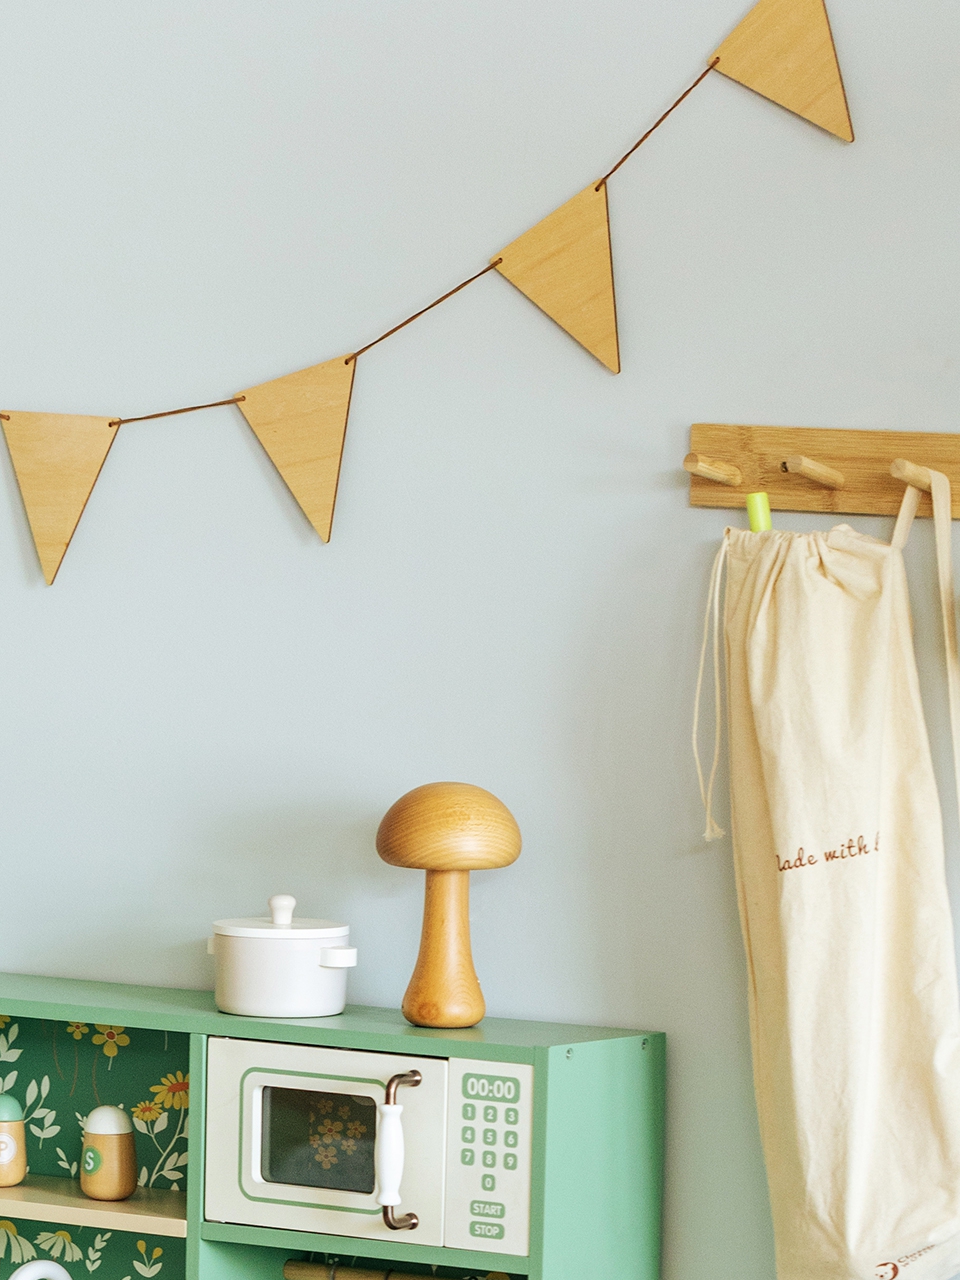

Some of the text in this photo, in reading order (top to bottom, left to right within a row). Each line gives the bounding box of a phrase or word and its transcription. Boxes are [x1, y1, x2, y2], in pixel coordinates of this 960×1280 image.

[824, 835, 869, 862] with
[467, 1078, 515, 1099] 00:00
[467, 1107, 515, 1121] 1 2 3
[465, 1130, 514, 1144] 4 5 6
[85, 1152, 94, 1170] S
[465, 1152, 513, 1166] 7 8 9
[485, 1178, 492, 1187] 0
[473, 1203, 502, 1216] START
[474, 1225, 499, 1236] STOP
